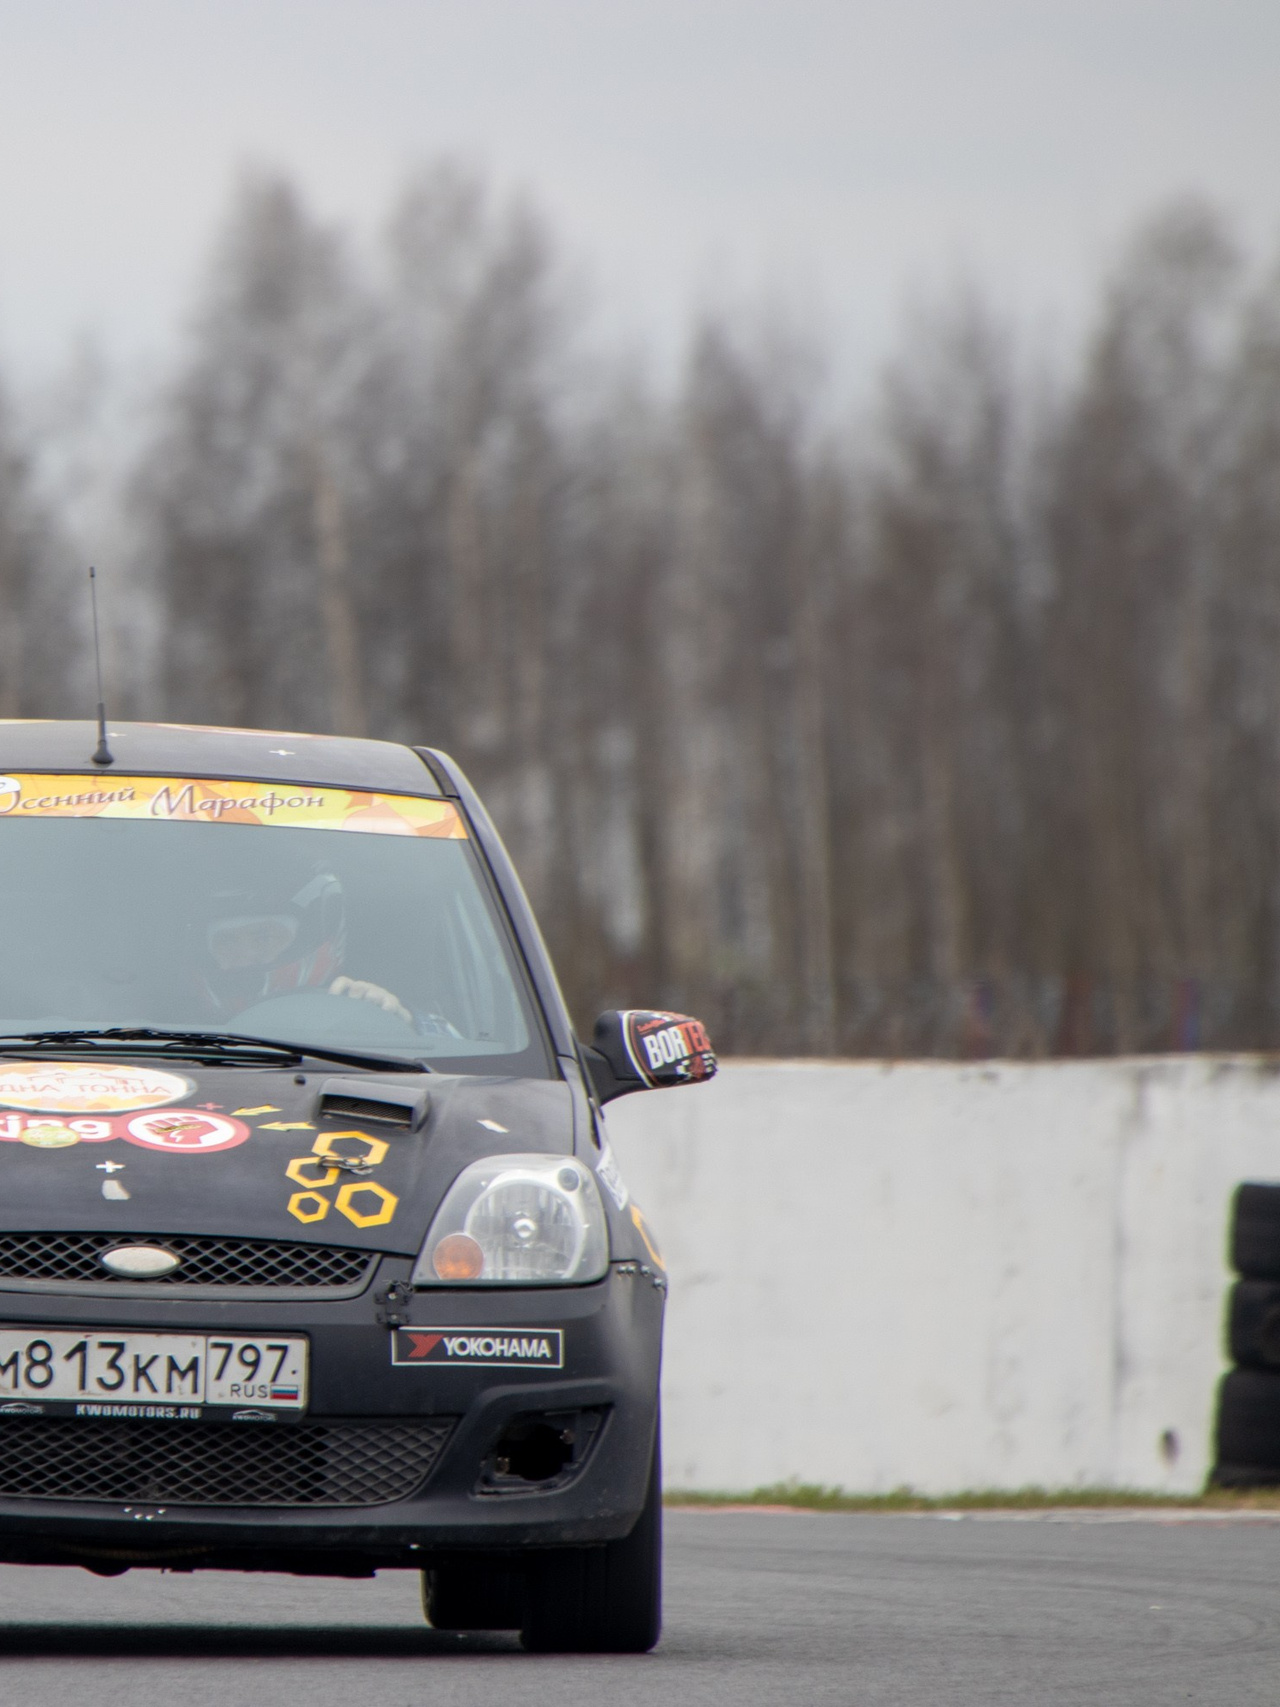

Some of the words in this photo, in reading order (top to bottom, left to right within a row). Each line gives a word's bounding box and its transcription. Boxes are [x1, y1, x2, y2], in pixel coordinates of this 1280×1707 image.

[150, 784, 325, 818] Марафон
[77, 1083, 173, 1095] ТОННА
[442, 1336, 552, 1358] YOKOHAMA
[210, 1342, 289, 1383] 797
[230, 1383, 268, 1398] RUS
